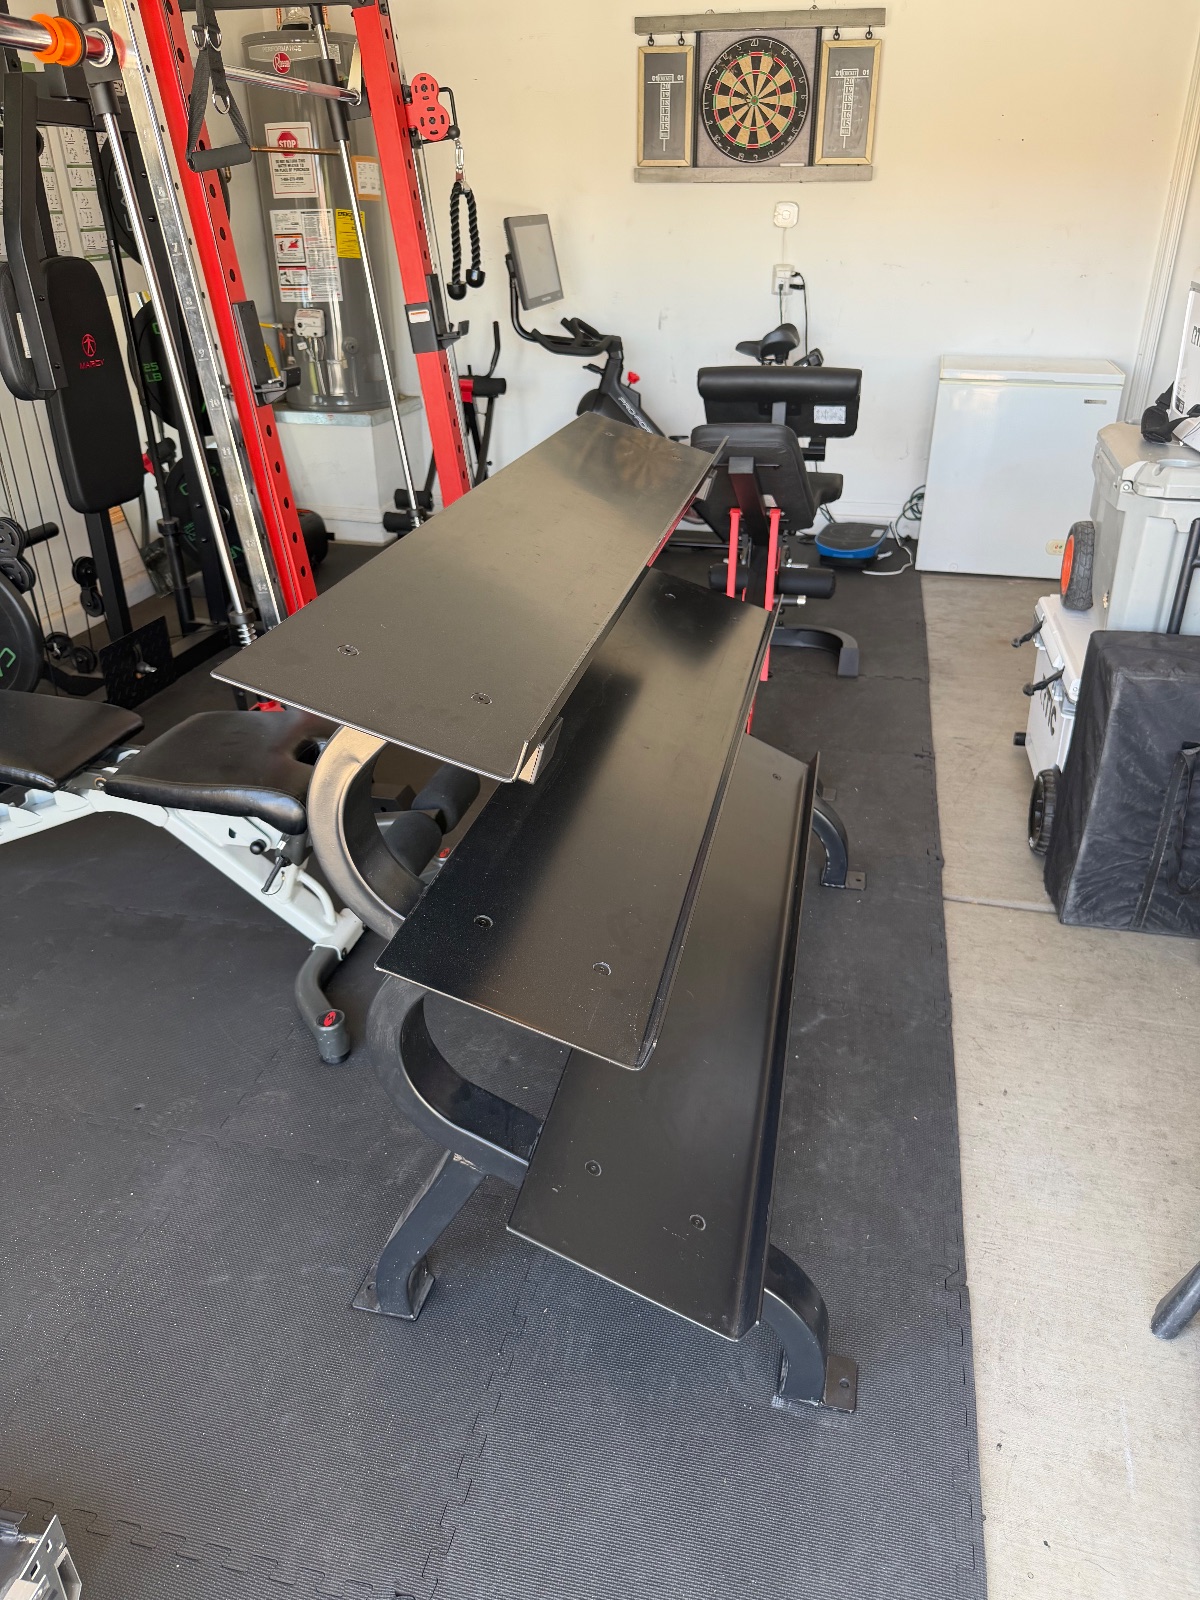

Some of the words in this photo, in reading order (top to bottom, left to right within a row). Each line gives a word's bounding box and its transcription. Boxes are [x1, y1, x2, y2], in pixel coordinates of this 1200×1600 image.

[262, 45, 302, 53] PERFORMANCE
[842, 119, 850, 127] 15
[278, 139, 297, 148] STOP
[198, 348, 205, 358] 9
[79, 358, 105, 370] MARCY
[142, 362, 159, 372] 25
[145, 372, 162, 383] LB
[209, 398, 220, 408] 10
